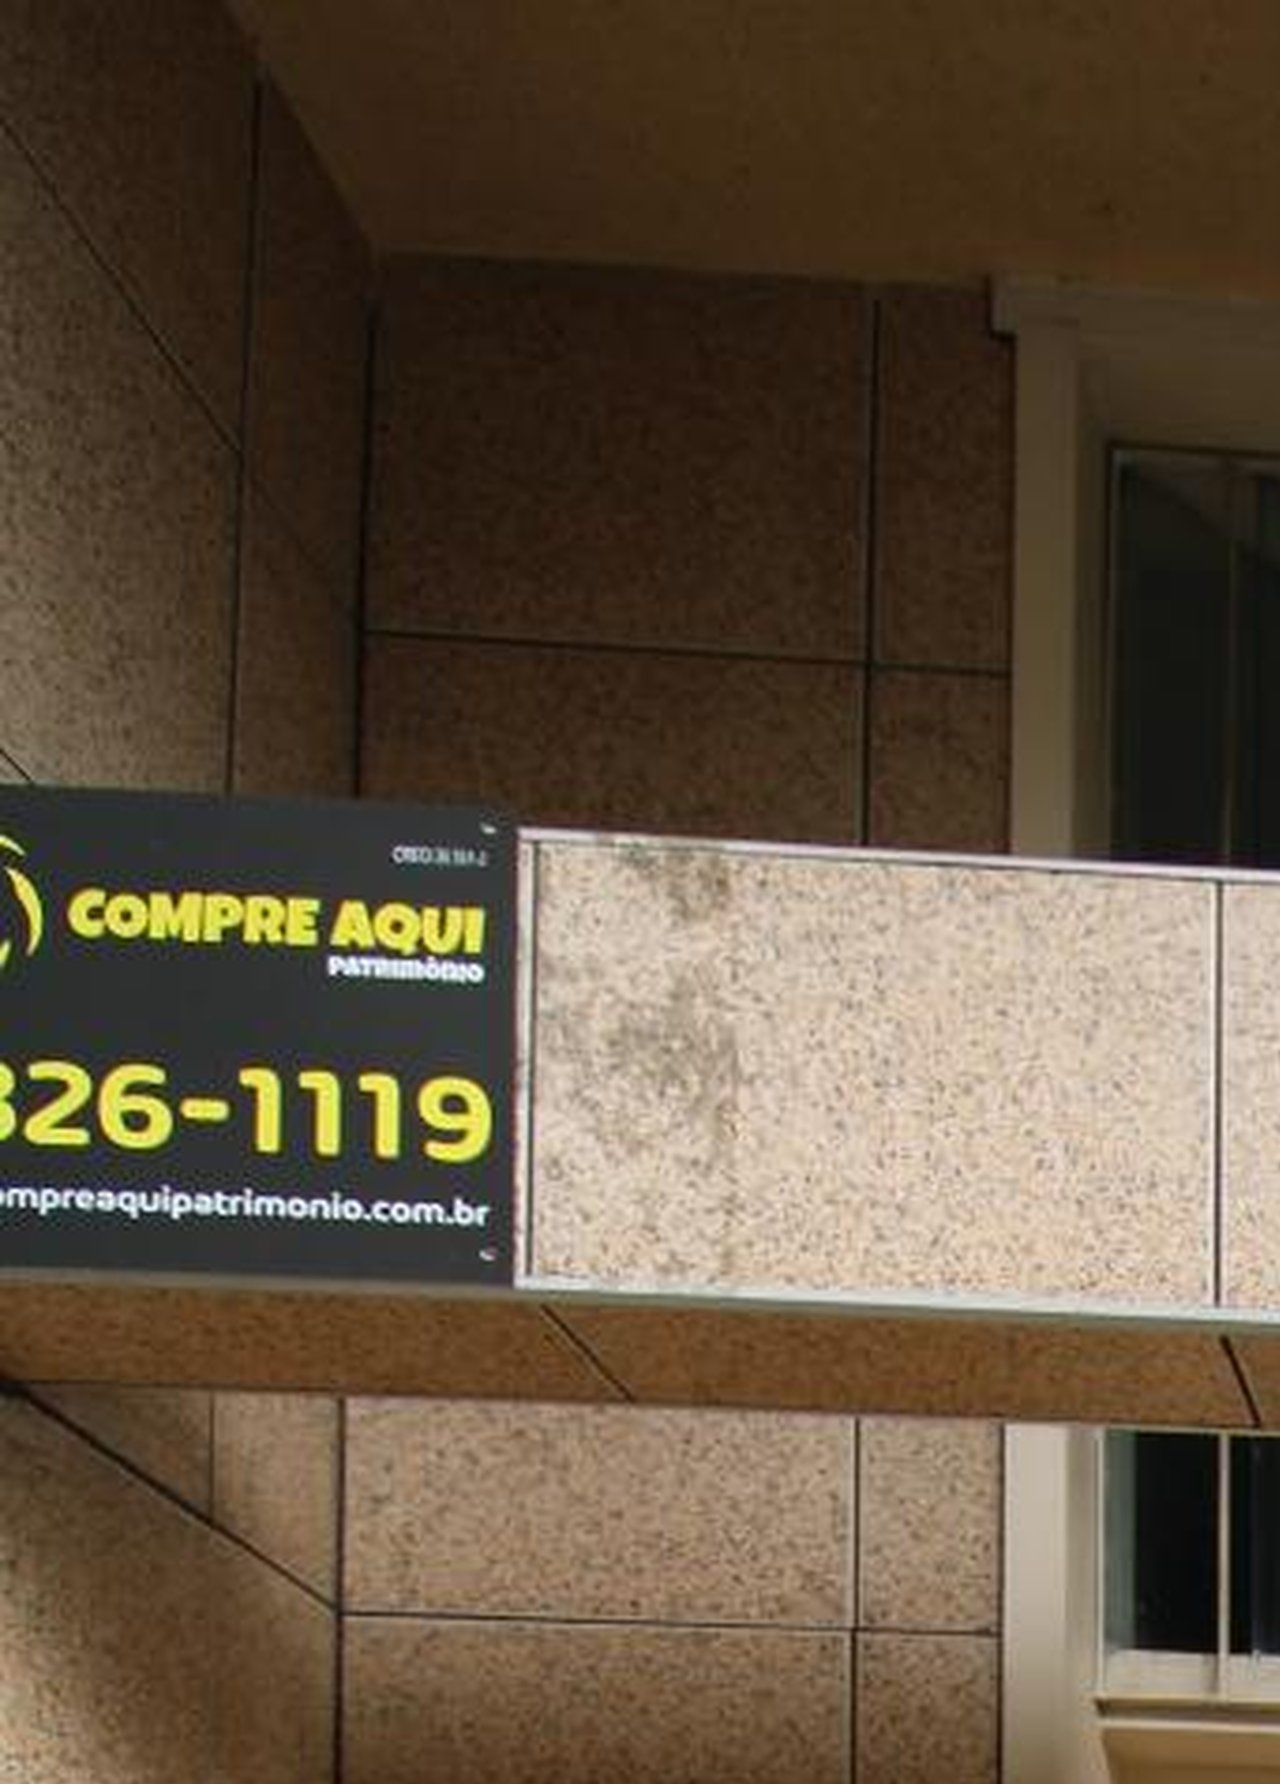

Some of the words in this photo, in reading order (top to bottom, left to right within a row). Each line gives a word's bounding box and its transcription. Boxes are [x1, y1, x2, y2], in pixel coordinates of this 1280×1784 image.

[68, 888, 320, 946] COMPRE
[329, 899, 486, 956] AQUI
[0, 1060, 494, 1163] 26-1119
[0, 1184, 489, 1226] mpreaquipatrimonio.com.br
